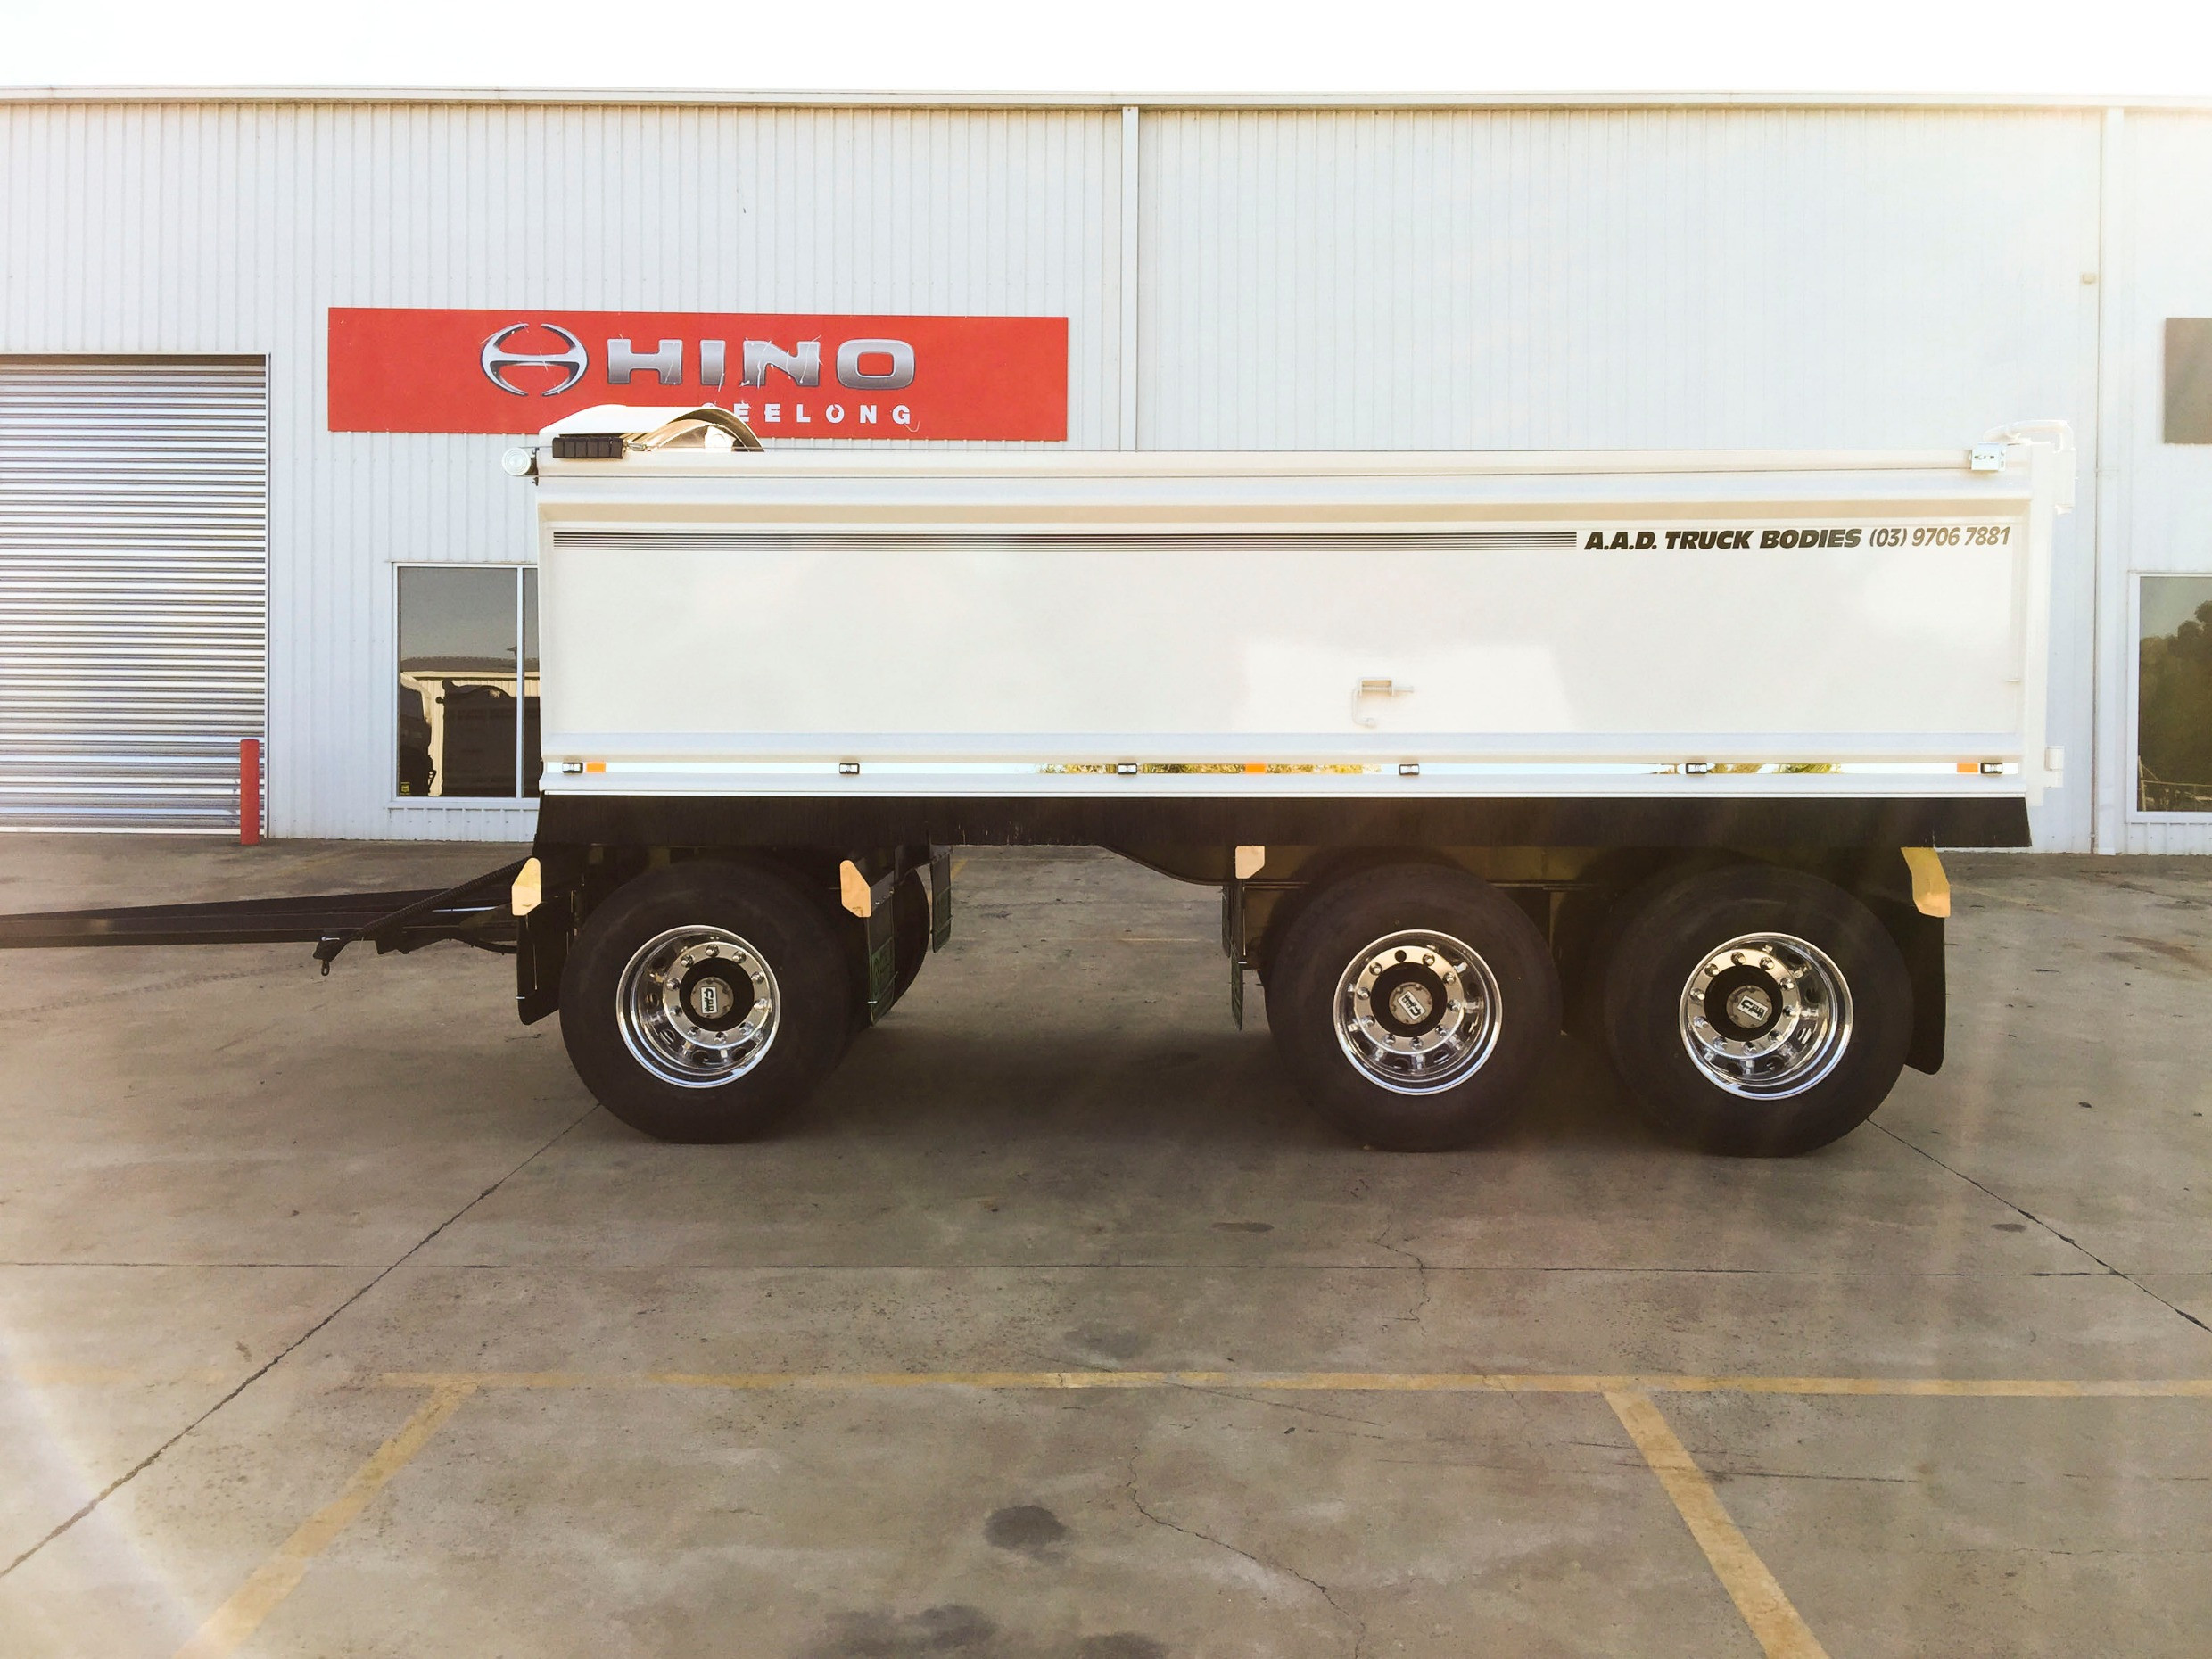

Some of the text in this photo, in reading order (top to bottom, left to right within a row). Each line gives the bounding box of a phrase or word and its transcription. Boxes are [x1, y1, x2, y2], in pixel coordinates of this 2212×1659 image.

[607, 338, 915, 390] HINO
[701, 402, 911, 425] EELONG
[1584, 526, 2011, 550] A.A.D. TRUCK BODIES (03) 9706 7881
